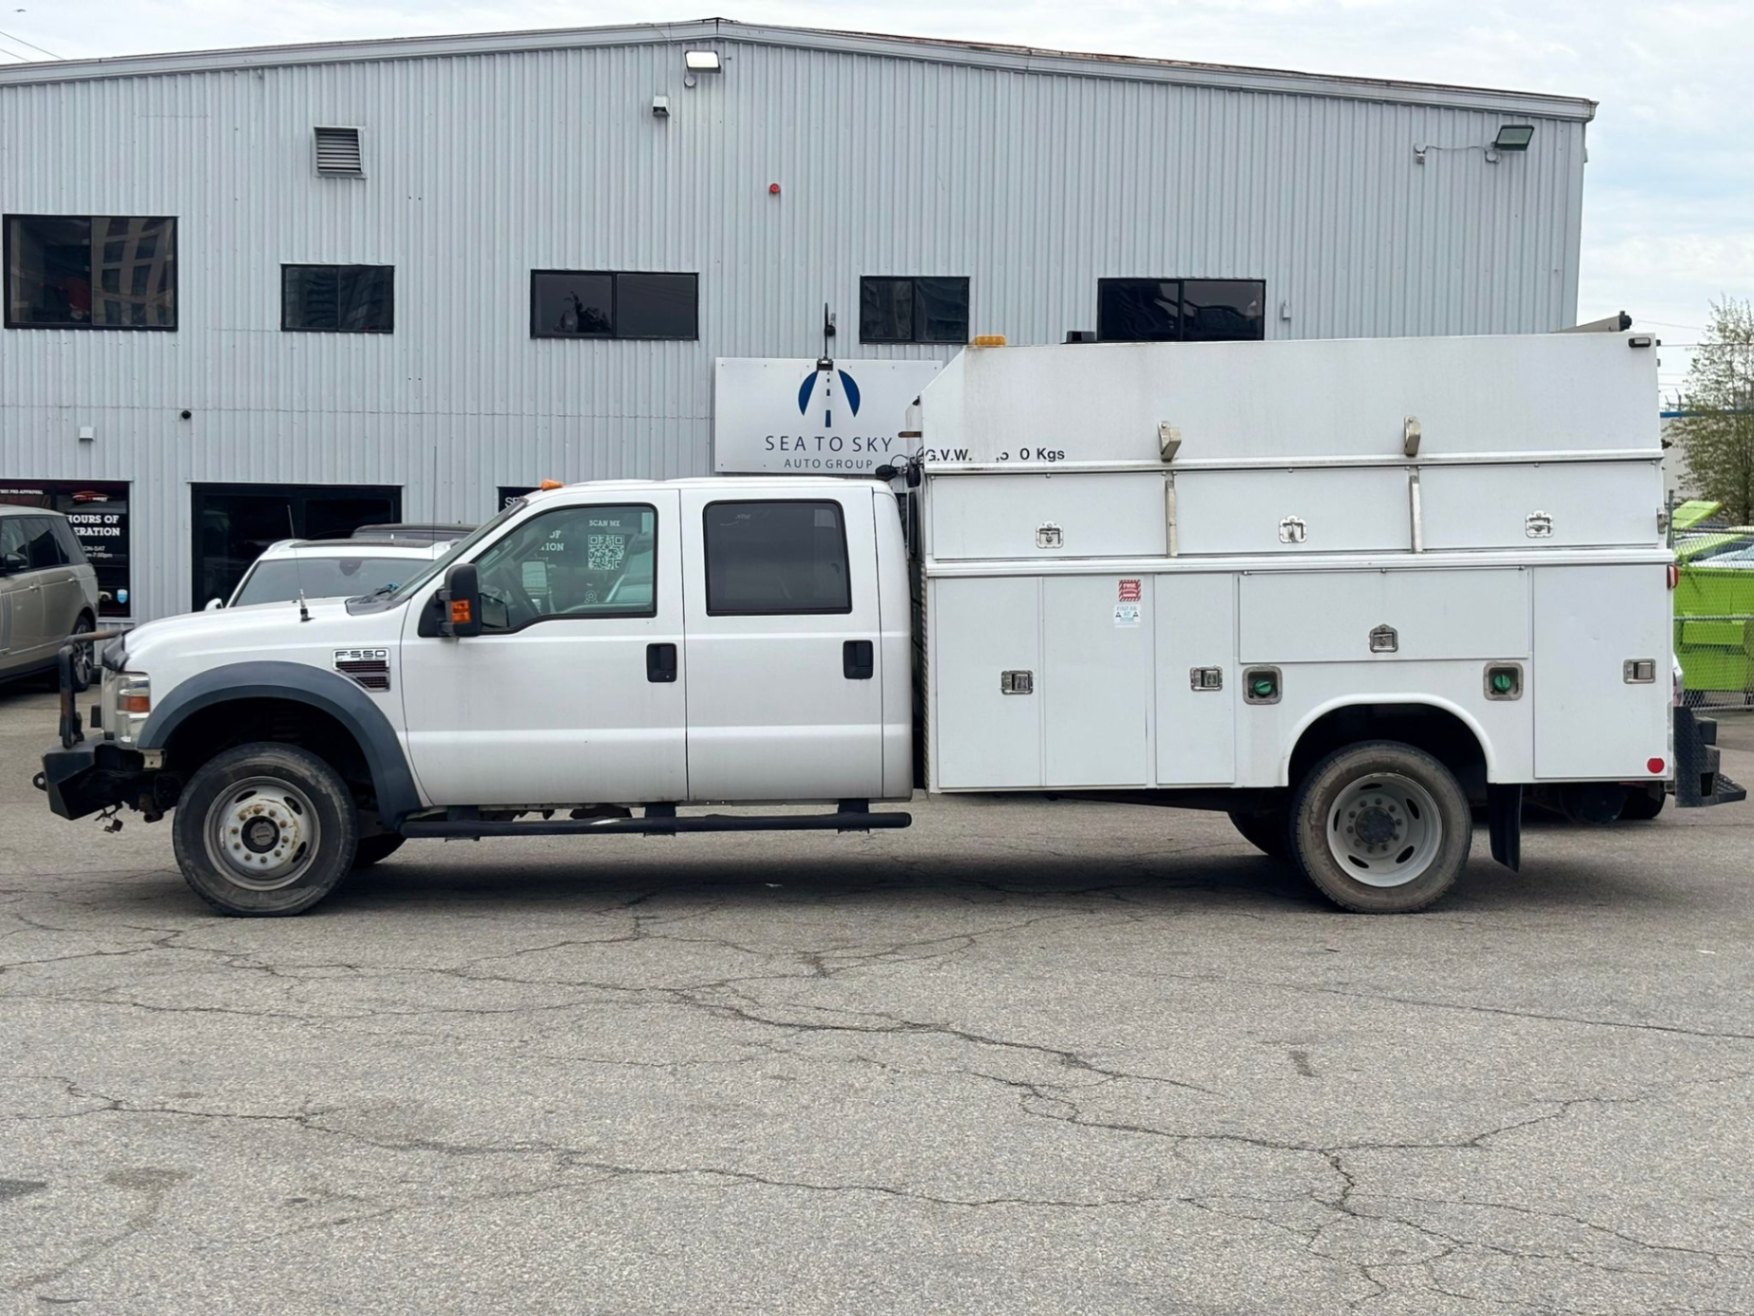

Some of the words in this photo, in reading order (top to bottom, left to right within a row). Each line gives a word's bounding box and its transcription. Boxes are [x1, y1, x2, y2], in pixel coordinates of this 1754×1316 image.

[765, 435, 806, 451] SEA
[814, 436, 843, 452] TO
[852, 437, 892, 452] SKY
[1036, 448, 1065, 462] Kgs
[784, 459, 821, 468] AUTO
[825, 459, 873, 469] GROUP
[104, 515, 119, 524] OF
[73, 527, 120, 536] ERATION
[335, 650, 387, 659] F-550
